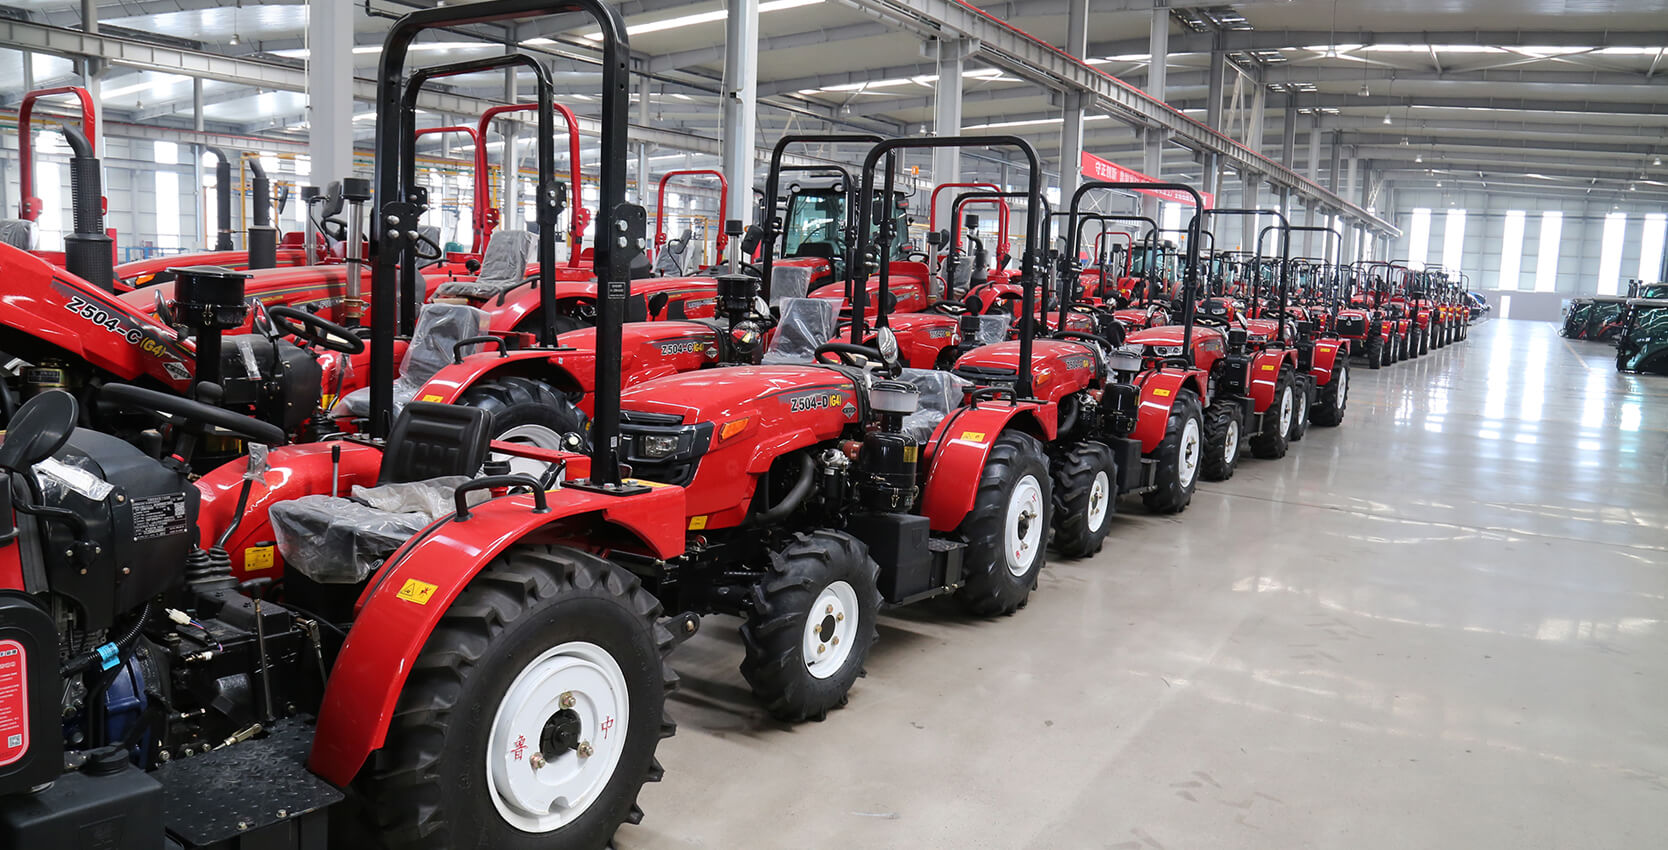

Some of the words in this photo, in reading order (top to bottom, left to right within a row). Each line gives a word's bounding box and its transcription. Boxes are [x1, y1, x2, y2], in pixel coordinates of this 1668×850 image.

[64, 295, 143, 344] Z504-C
[140, 337, 167, 357] (G4)
[661, 342, 693, 356] Z504-C
[791, 393, 829, 413] Z504-D
[601, 715, 614, 739] 中
[511, 735, 528, 760] 鲁
